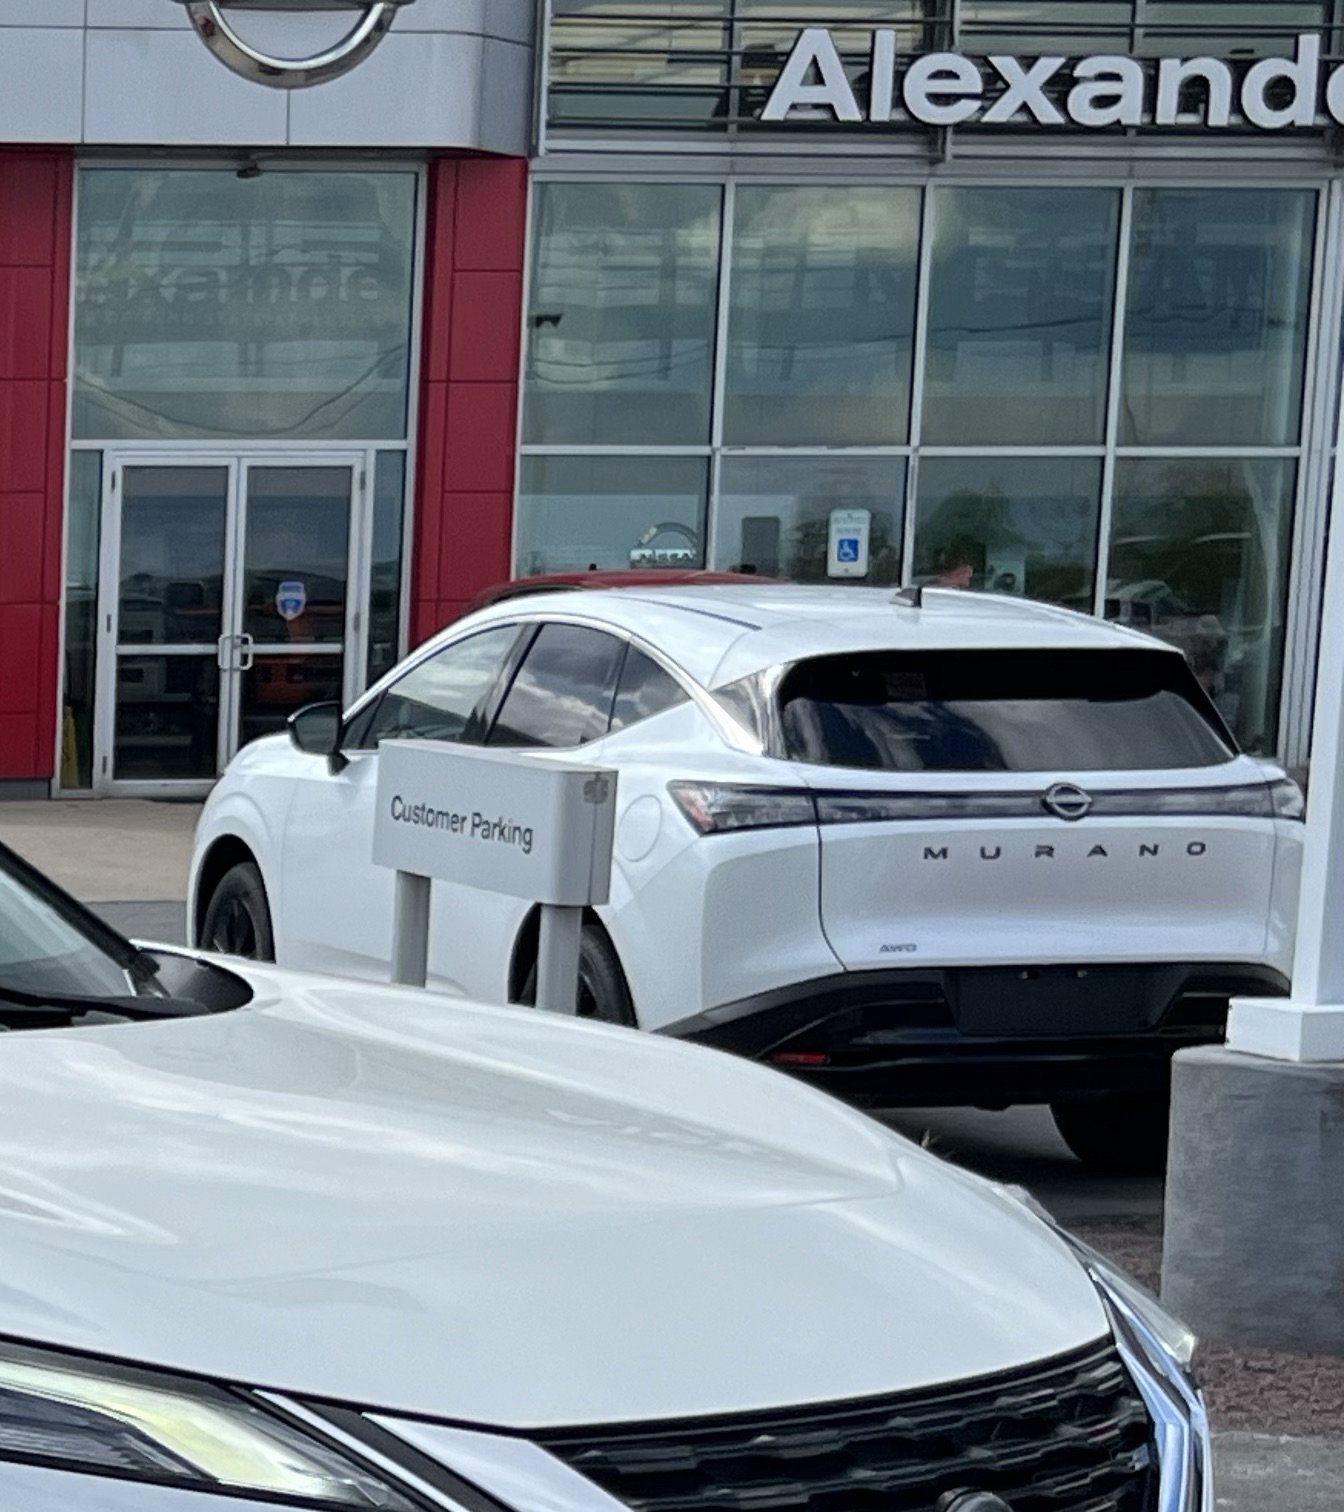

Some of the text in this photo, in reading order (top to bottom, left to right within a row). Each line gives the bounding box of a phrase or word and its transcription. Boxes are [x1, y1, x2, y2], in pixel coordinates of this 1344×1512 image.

[759, 27, 1344, 129] Alexand
[390, 795, 534, 855] Customer Parking
[923, 841, 1207, 860] MURANO
[879, 943, 918, 953] AWD
